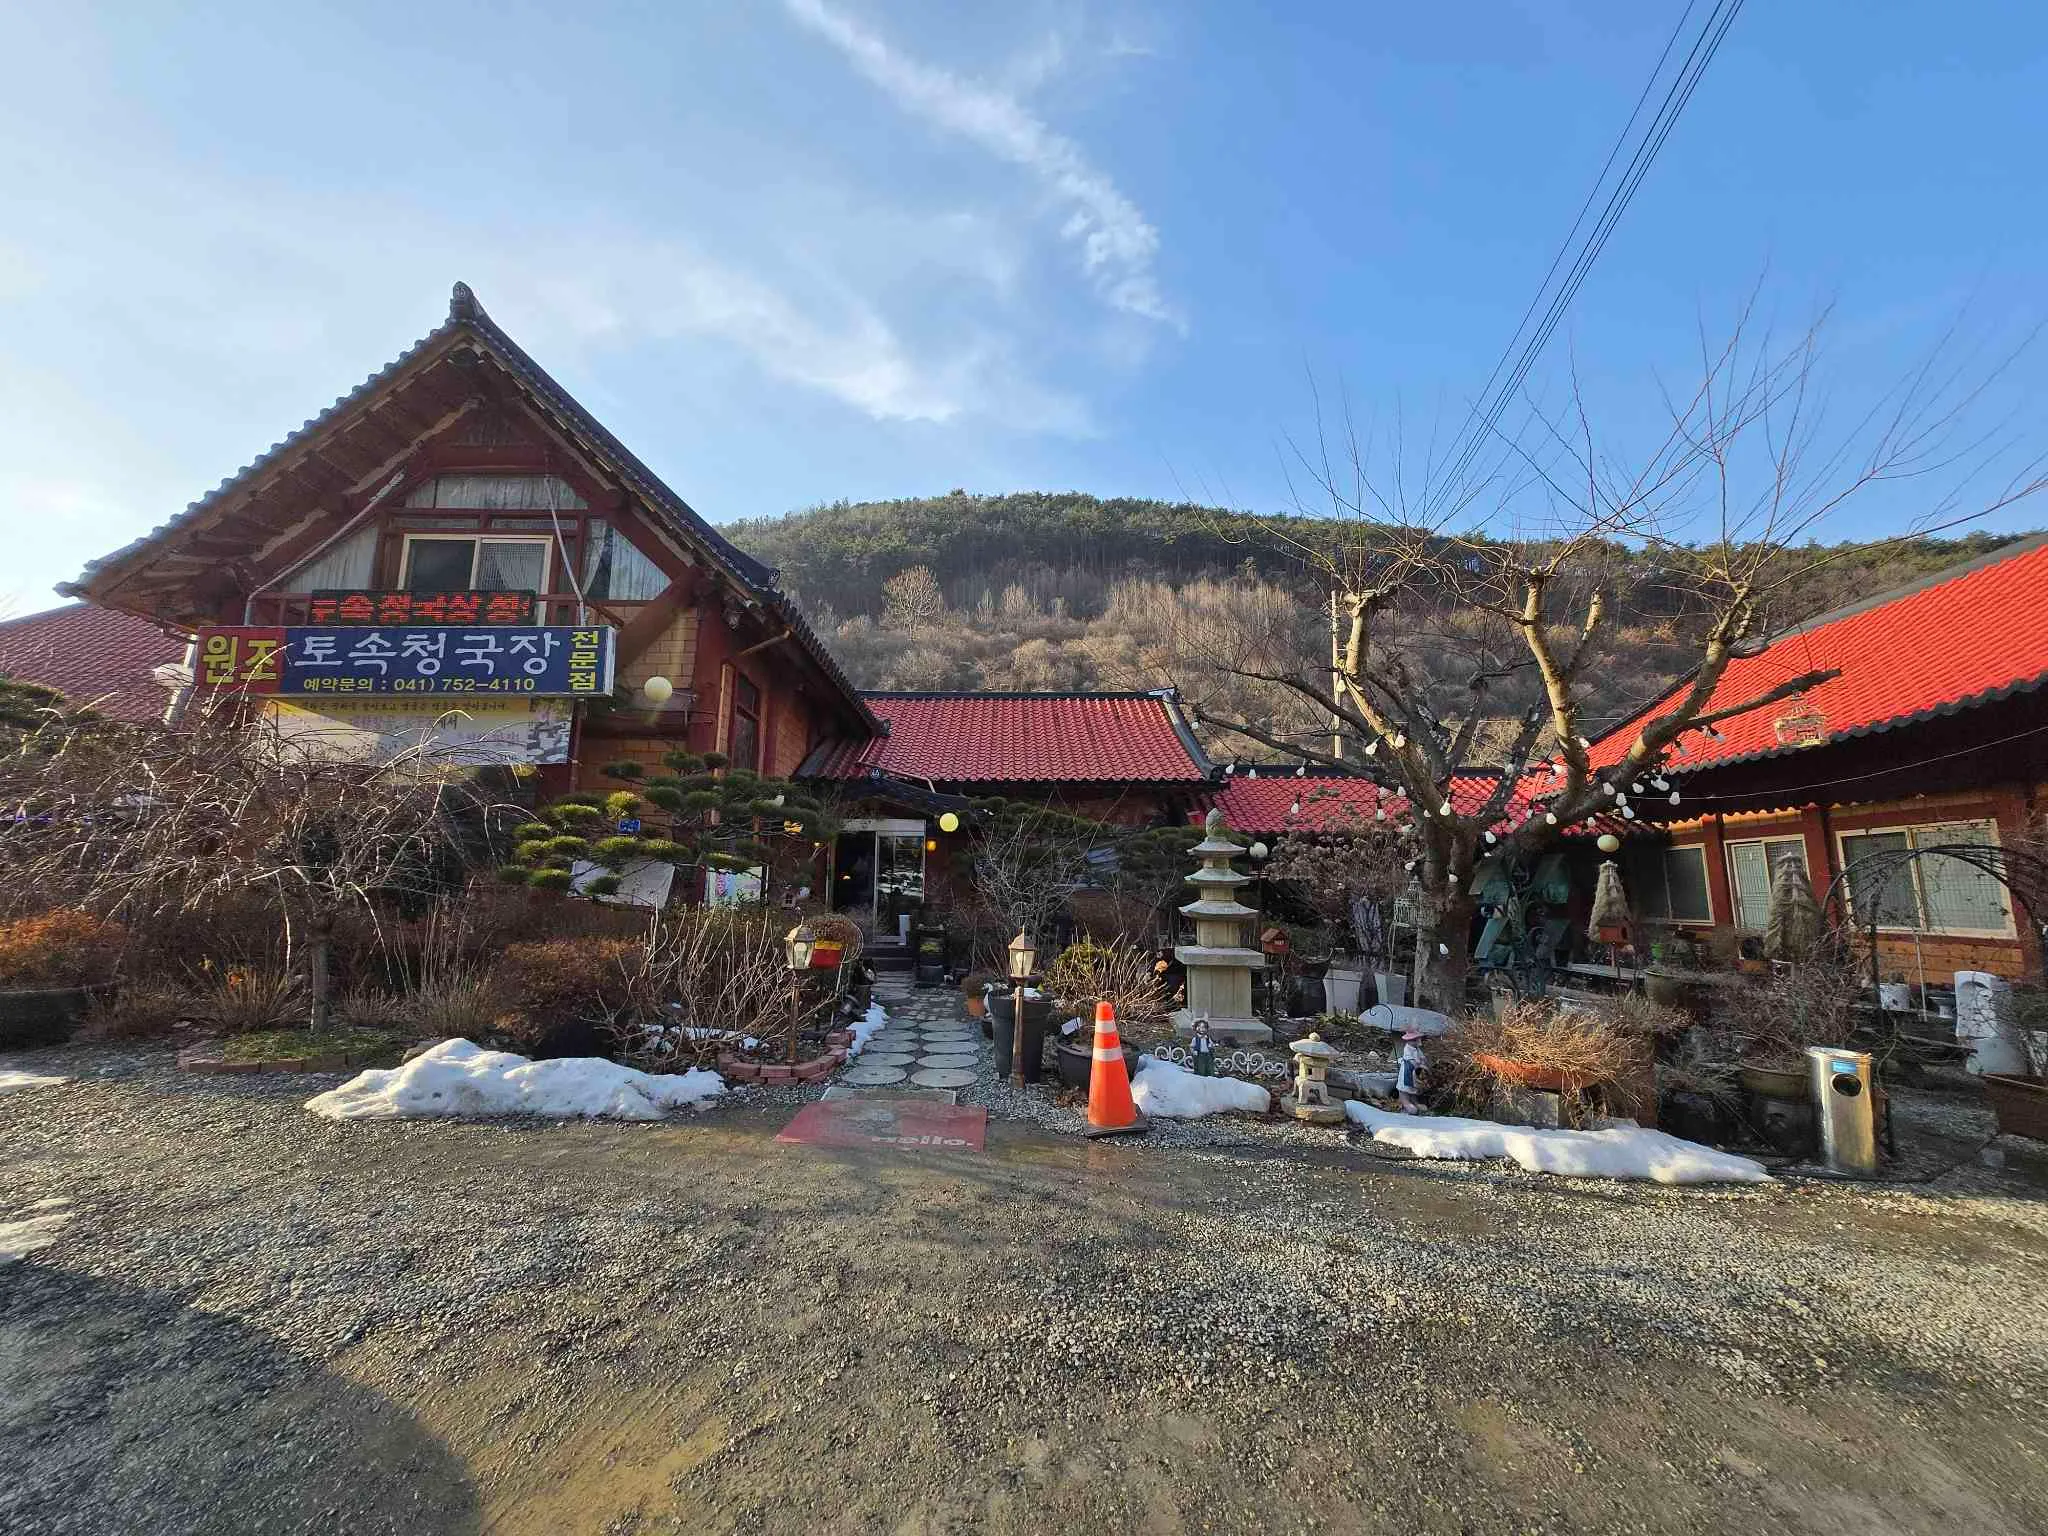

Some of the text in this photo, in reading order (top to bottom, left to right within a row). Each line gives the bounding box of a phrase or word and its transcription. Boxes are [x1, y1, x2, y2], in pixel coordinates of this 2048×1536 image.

[203, 631, 561, 684] 원조 토속청국장
[568, 630, 599, 691] 전문점
[303, 677, 373, 692] 예약문의
[394, 677, 435, 692] 041)
[442, 677, 535, 692] 752-4110
